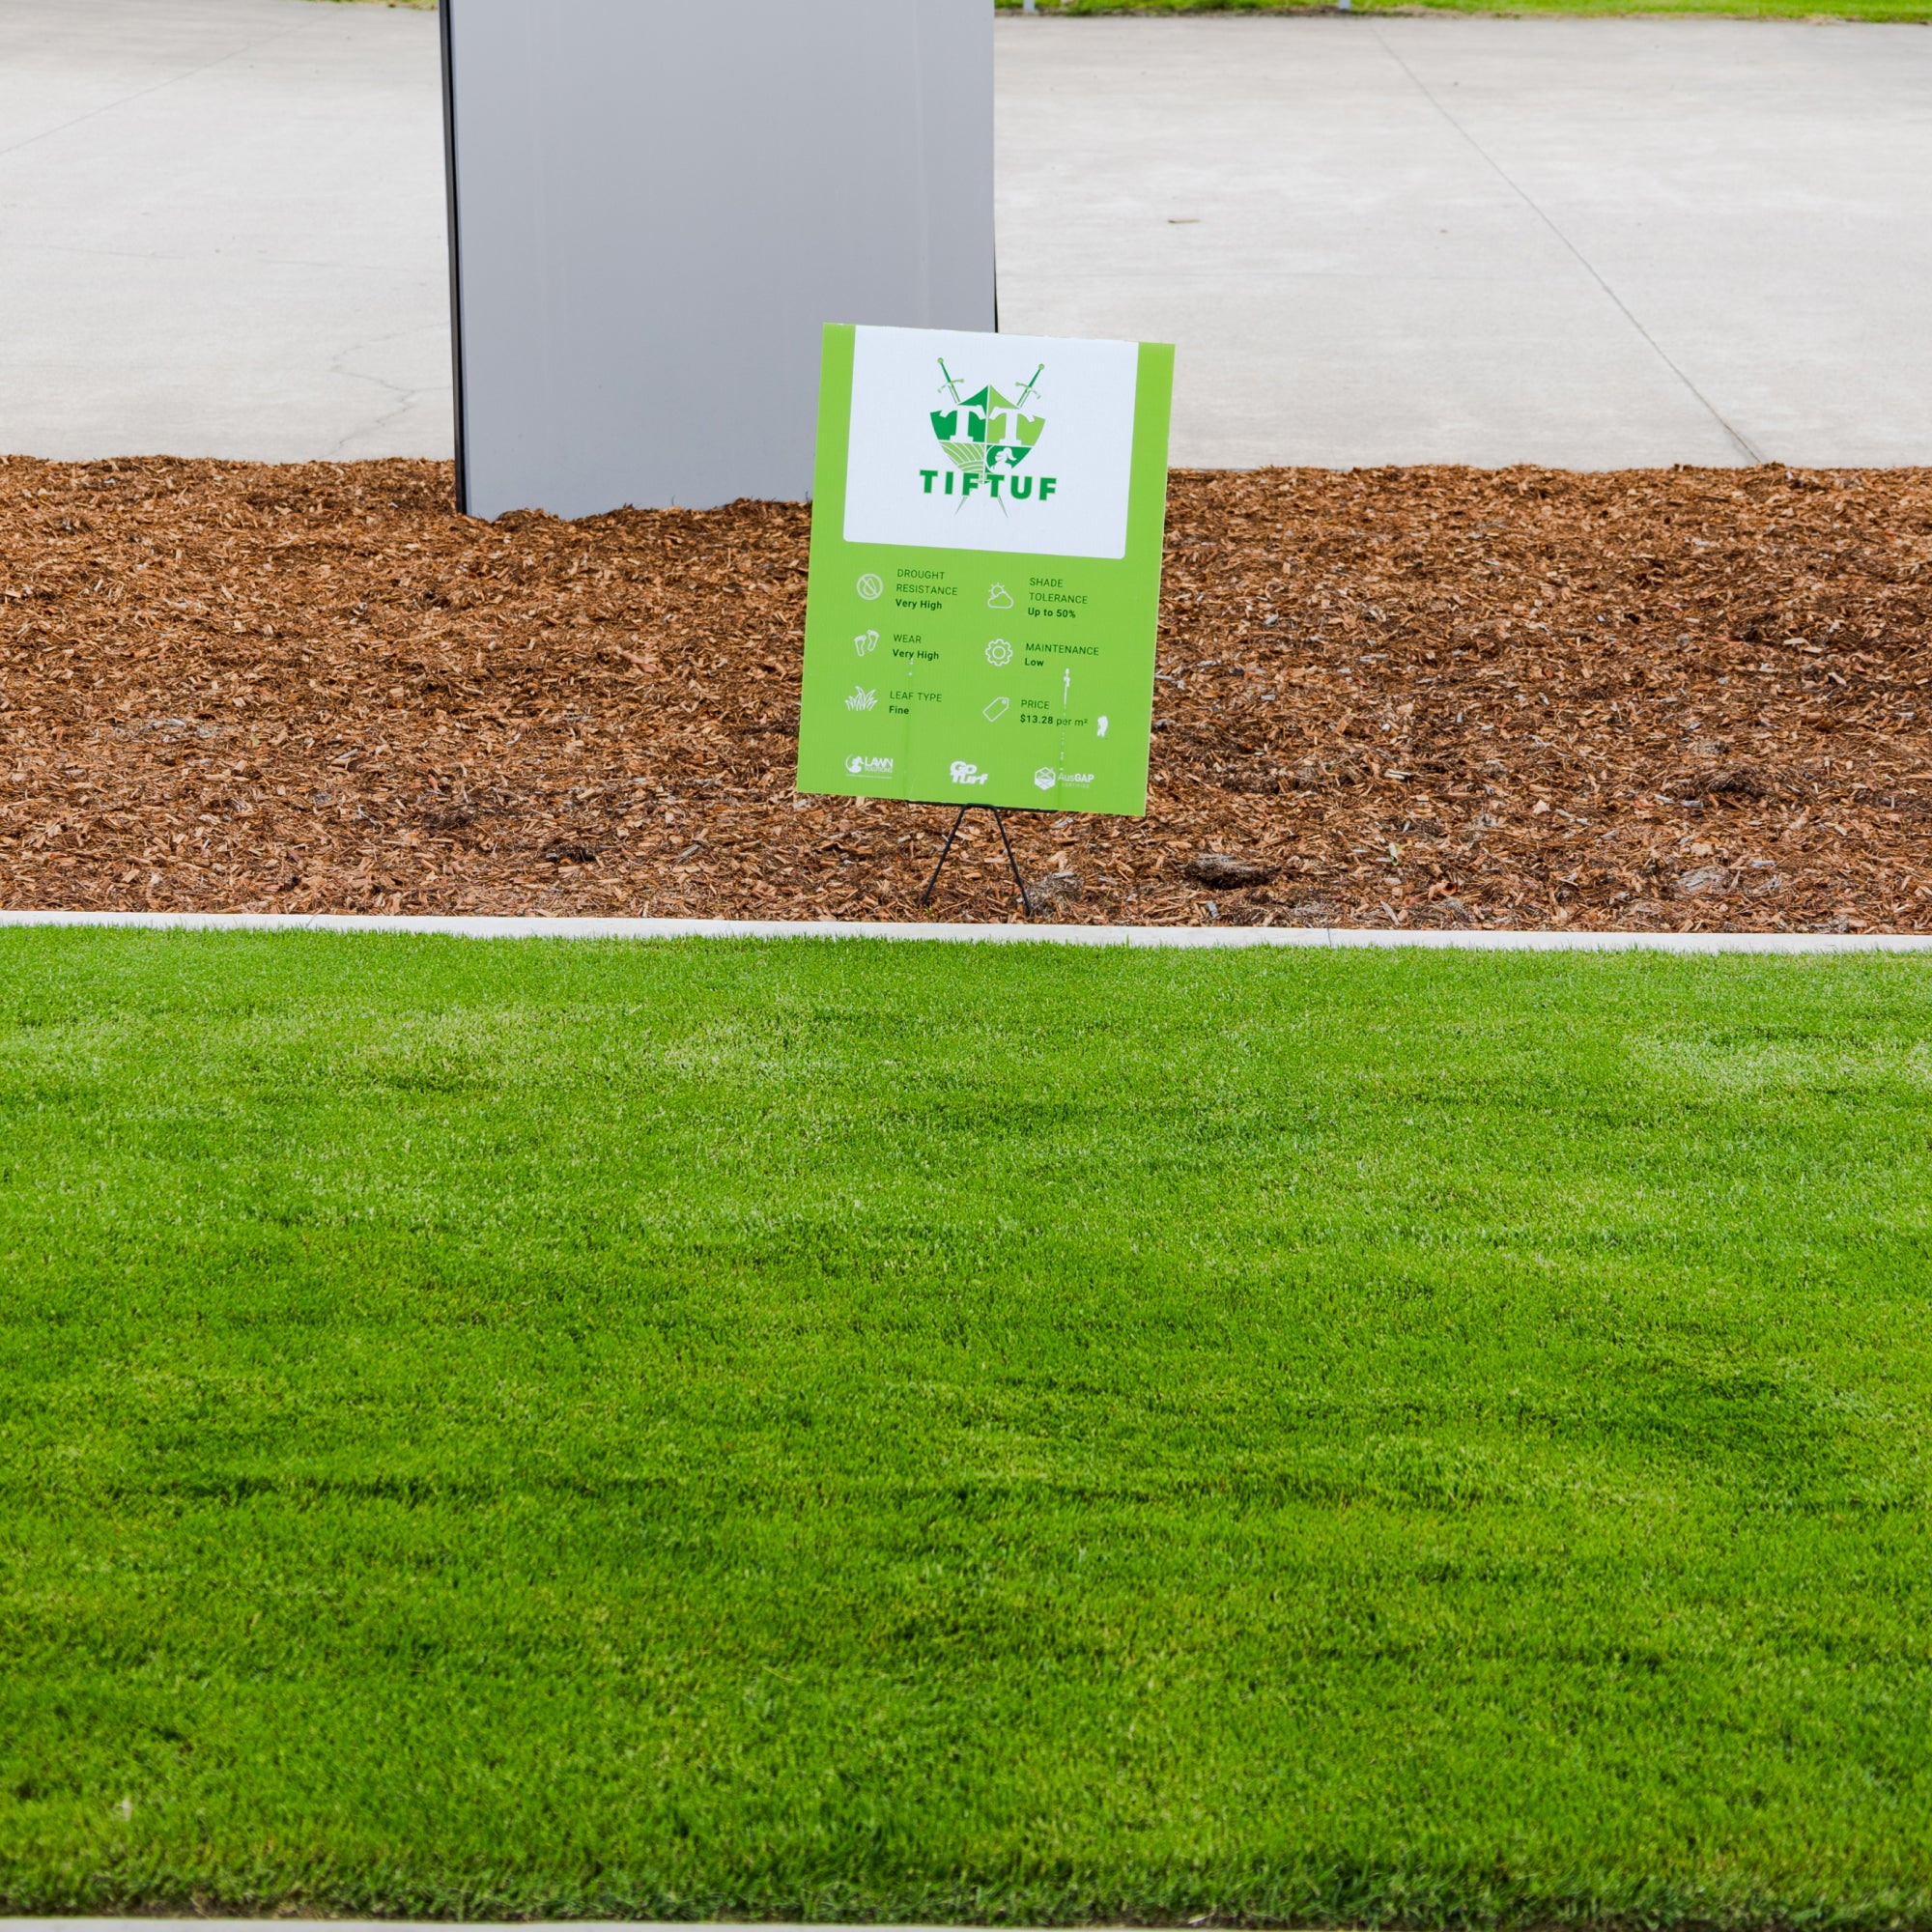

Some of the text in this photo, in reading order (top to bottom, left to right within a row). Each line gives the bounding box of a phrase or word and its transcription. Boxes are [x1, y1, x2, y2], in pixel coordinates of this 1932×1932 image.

[919, 469, 1058, 501] TIFTUF
[896, 568, 946, 581] DROUGHT
[895, 582, 958, 596] RESISTANCE
[1029, 577, 1064, 588] SHADE
[895, 598, 943, 611] Very High
[1028, 591, 1089, 605] TOLERANCE
[1027, 607, 1076, 618] Up to 50%
[893, 633, 923, 644] WEAR
[892, 648, 940, 662] Very High
[1025, 642, 1099, 657] MAINTENANCE
[1024, 657, 1044, 667] Low
[889, 690, 943, 703] LEAF TYPE
[888, 704, 910, 715] Fine
[1020, 698, 1051, 710] PRICE
[1019, 713, 1054, 725] $13.28
[1056, 718, 1072, 726] per
[865, 755, 894, 768] LAWN
